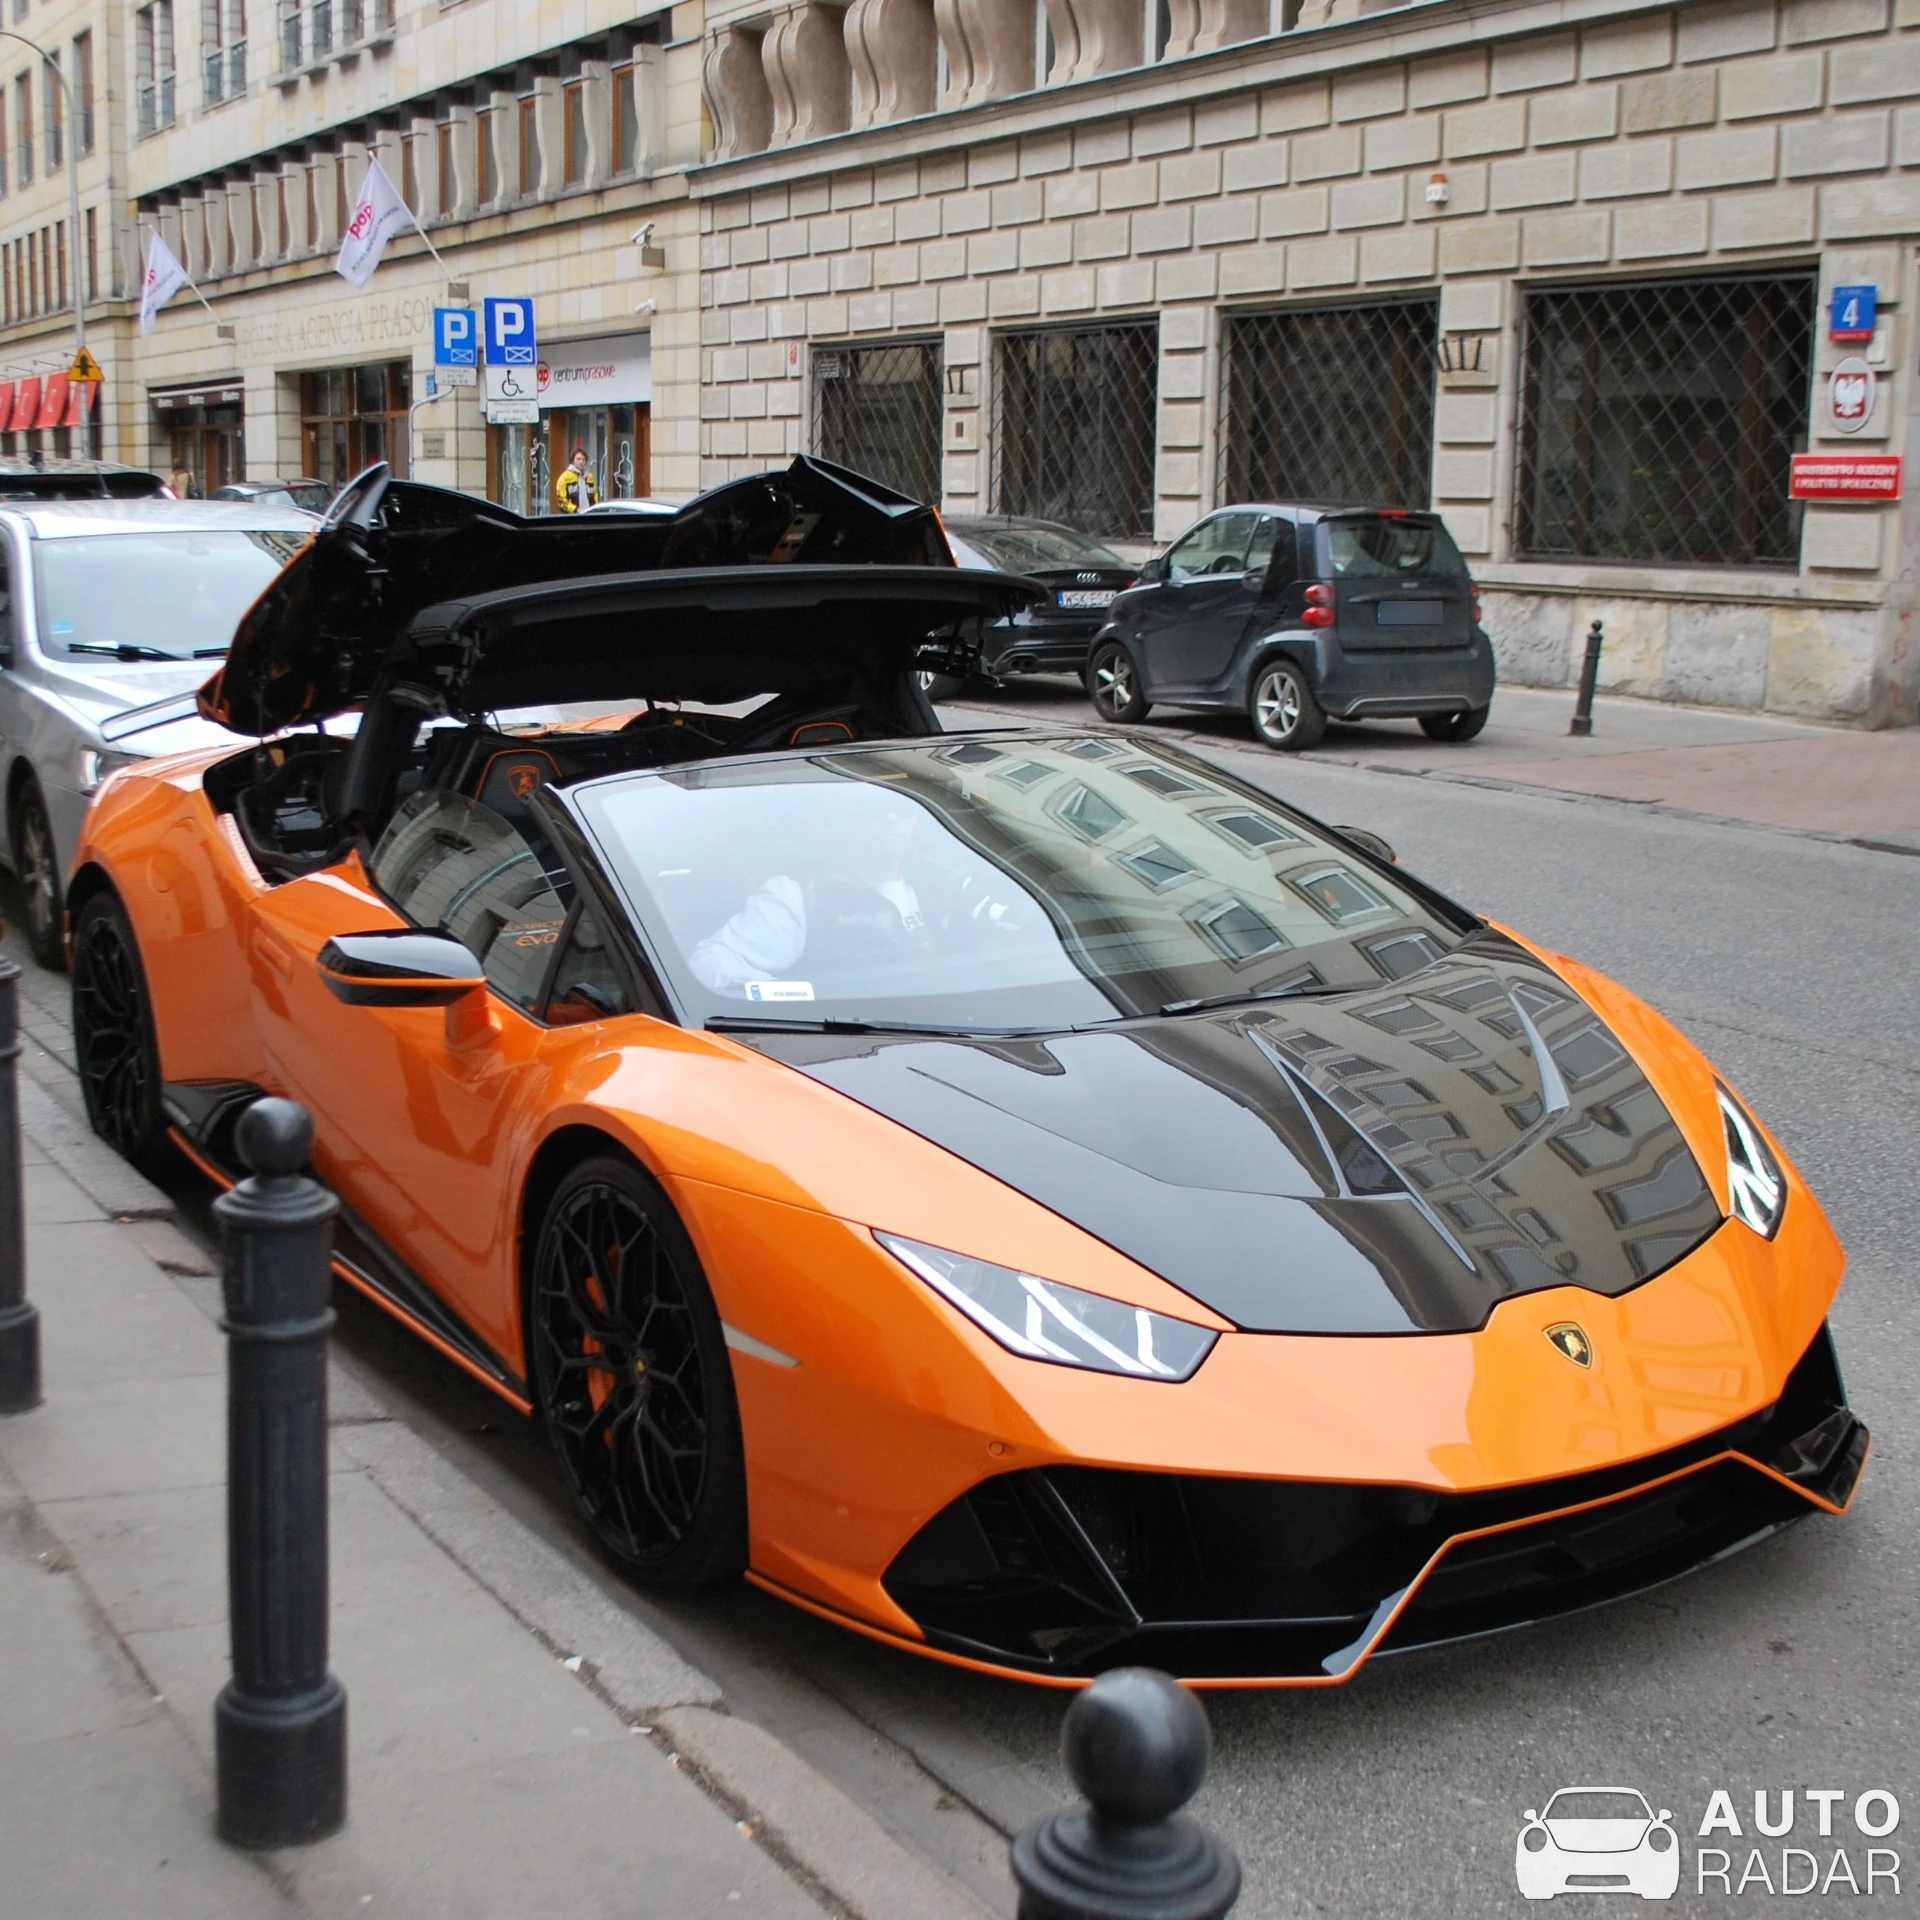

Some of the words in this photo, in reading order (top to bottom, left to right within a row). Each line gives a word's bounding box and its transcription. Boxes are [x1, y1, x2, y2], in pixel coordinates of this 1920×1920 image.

[300, 309, 366, 351] AGENCJA
[443, 312, 469, 349] P
[494, 302, 525, 347] P
[1842, 298, 1860, 328] 4
[515, 932, 559, 947] EVO
